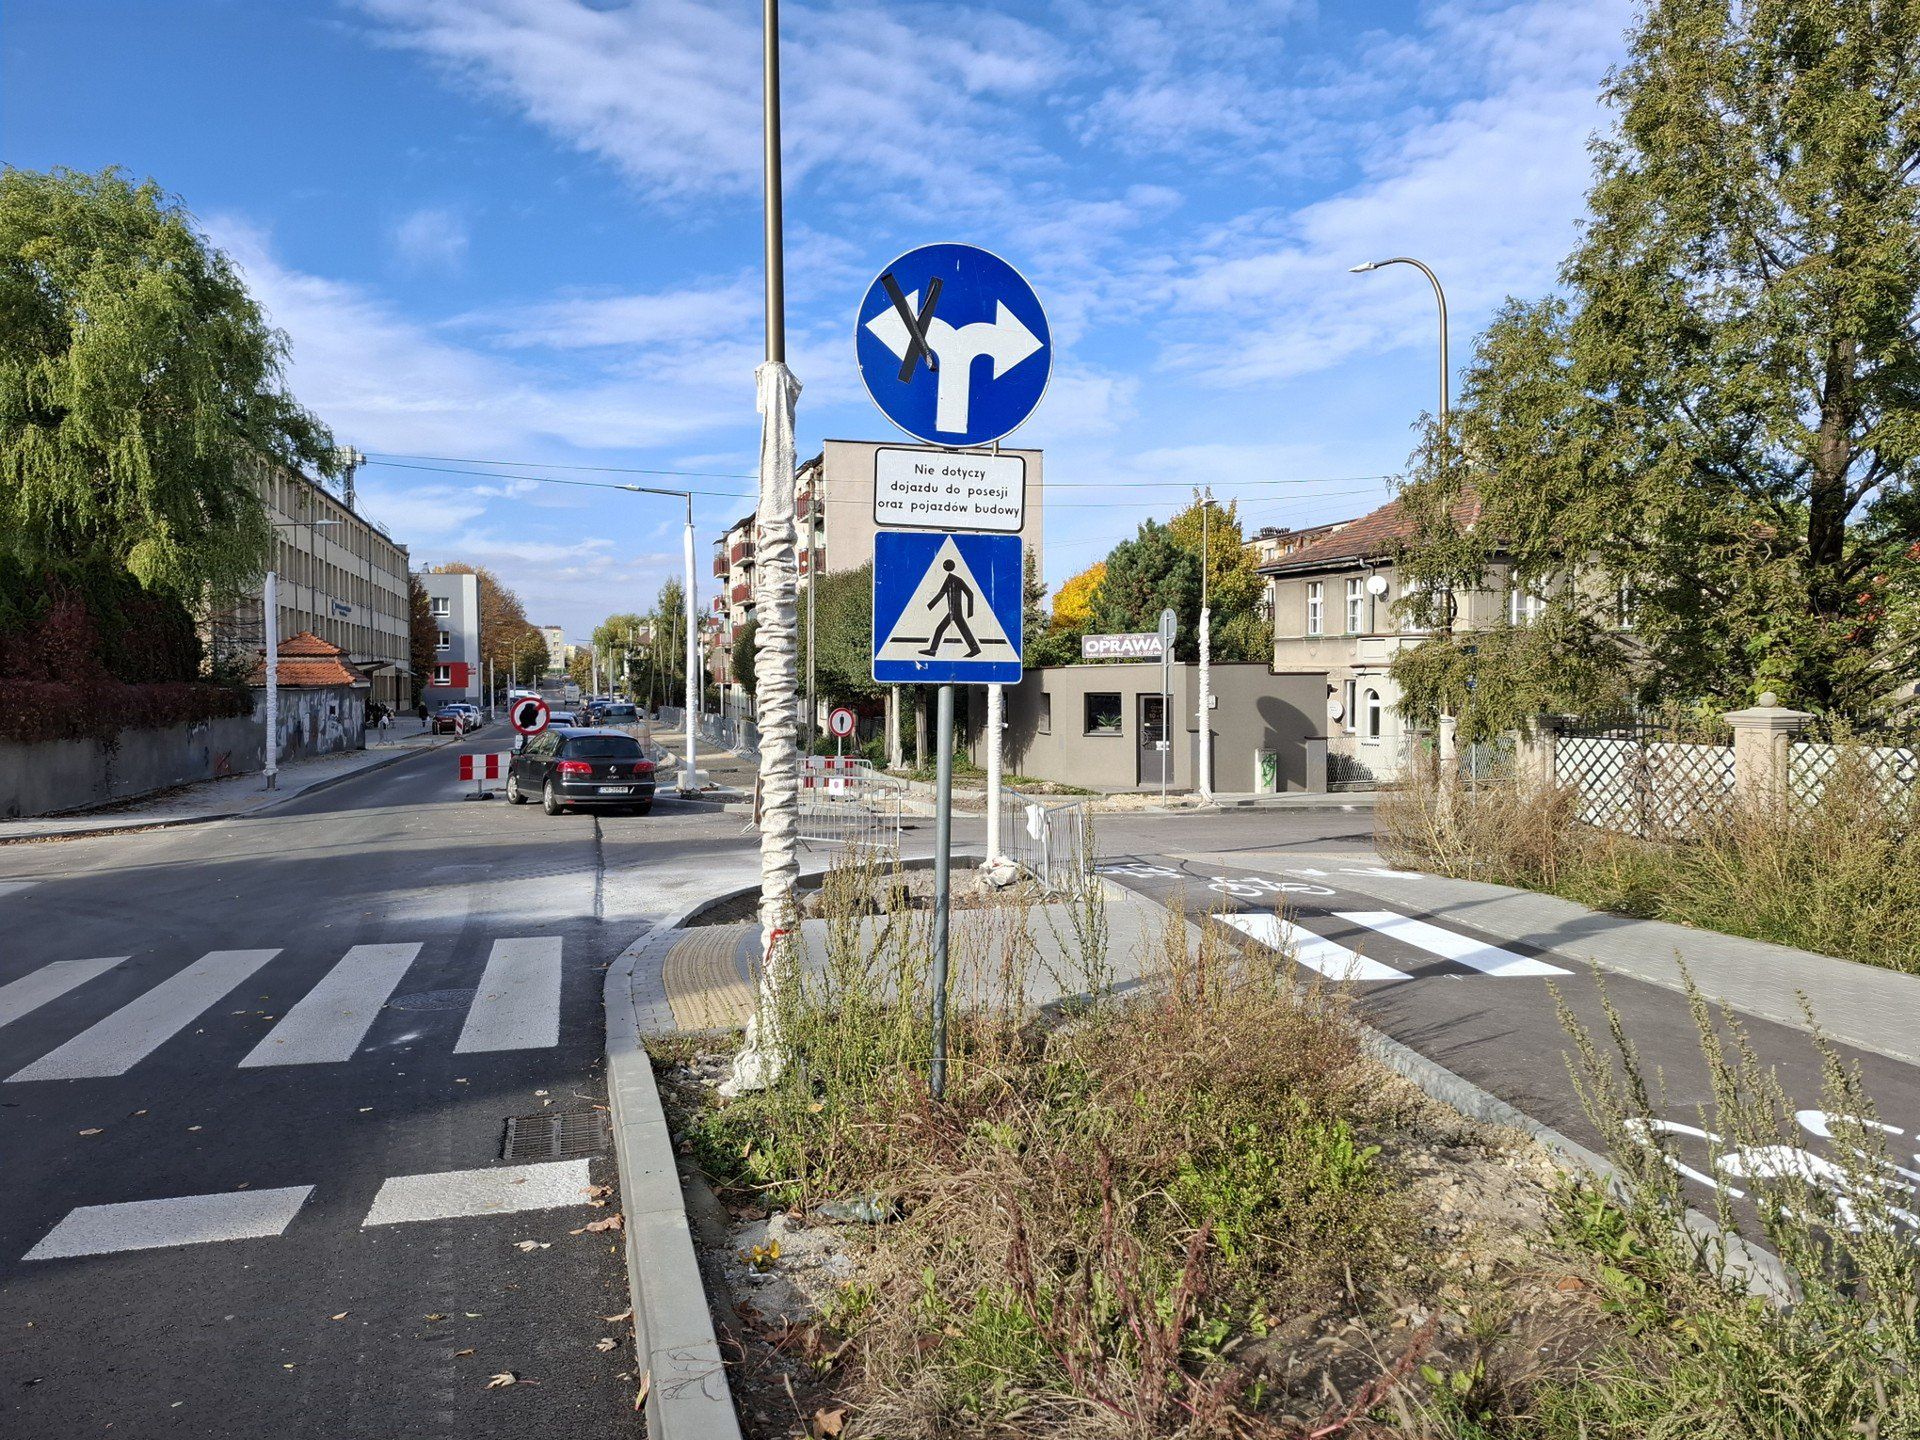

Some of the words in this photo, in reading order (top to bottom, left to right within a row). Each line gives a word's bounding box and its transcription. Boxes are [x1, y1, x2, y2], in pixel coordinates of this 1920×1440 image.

[914, 464, 935, 475] Nie
[942, 466, 986, 481] dotyczy
[890, 481, 939, 494] dojazdu
[945, 484, 961, 494] do
[967, 487, 1008, 499] posesji
[877, 500, 904, 509] oraz
[910, 500, 968, 513] pojazdów
[974, 503, 1020, 518] budowy
[1085, 637, 1163, 652] OPRAWA
